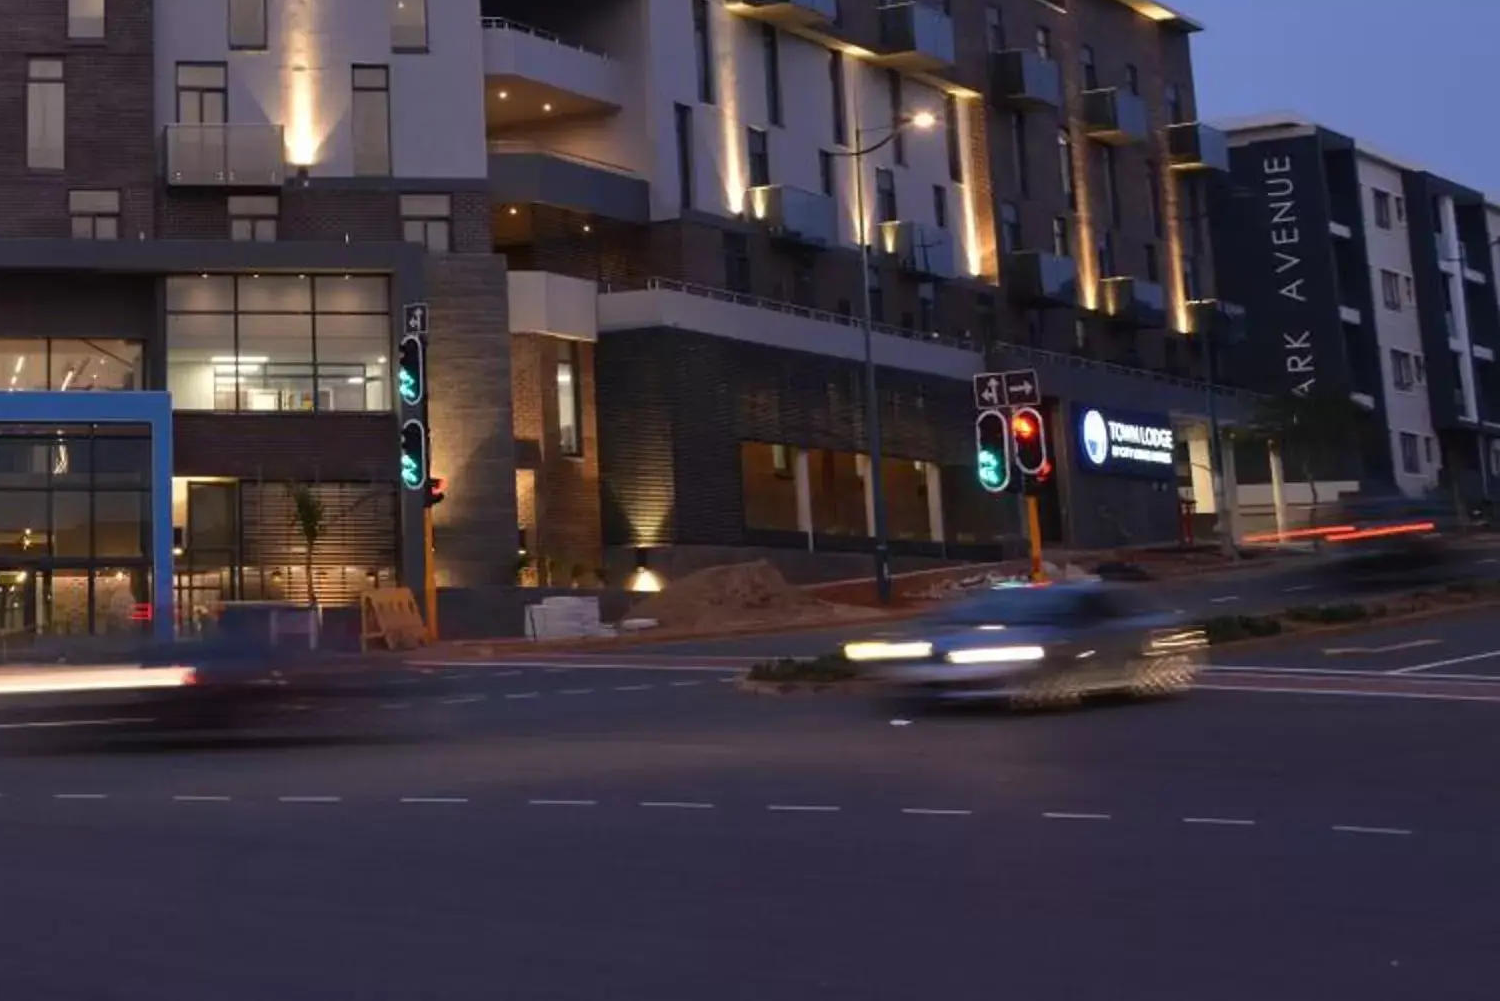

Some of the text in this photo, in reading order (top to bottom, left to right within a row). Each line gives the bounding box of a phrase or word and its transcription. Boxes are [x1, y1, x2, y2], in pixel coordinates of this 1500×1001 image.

[1263, 155, 1317, 399] ARK AVENUE
[1108, 420, 1174, 449] TOWN LODGE
